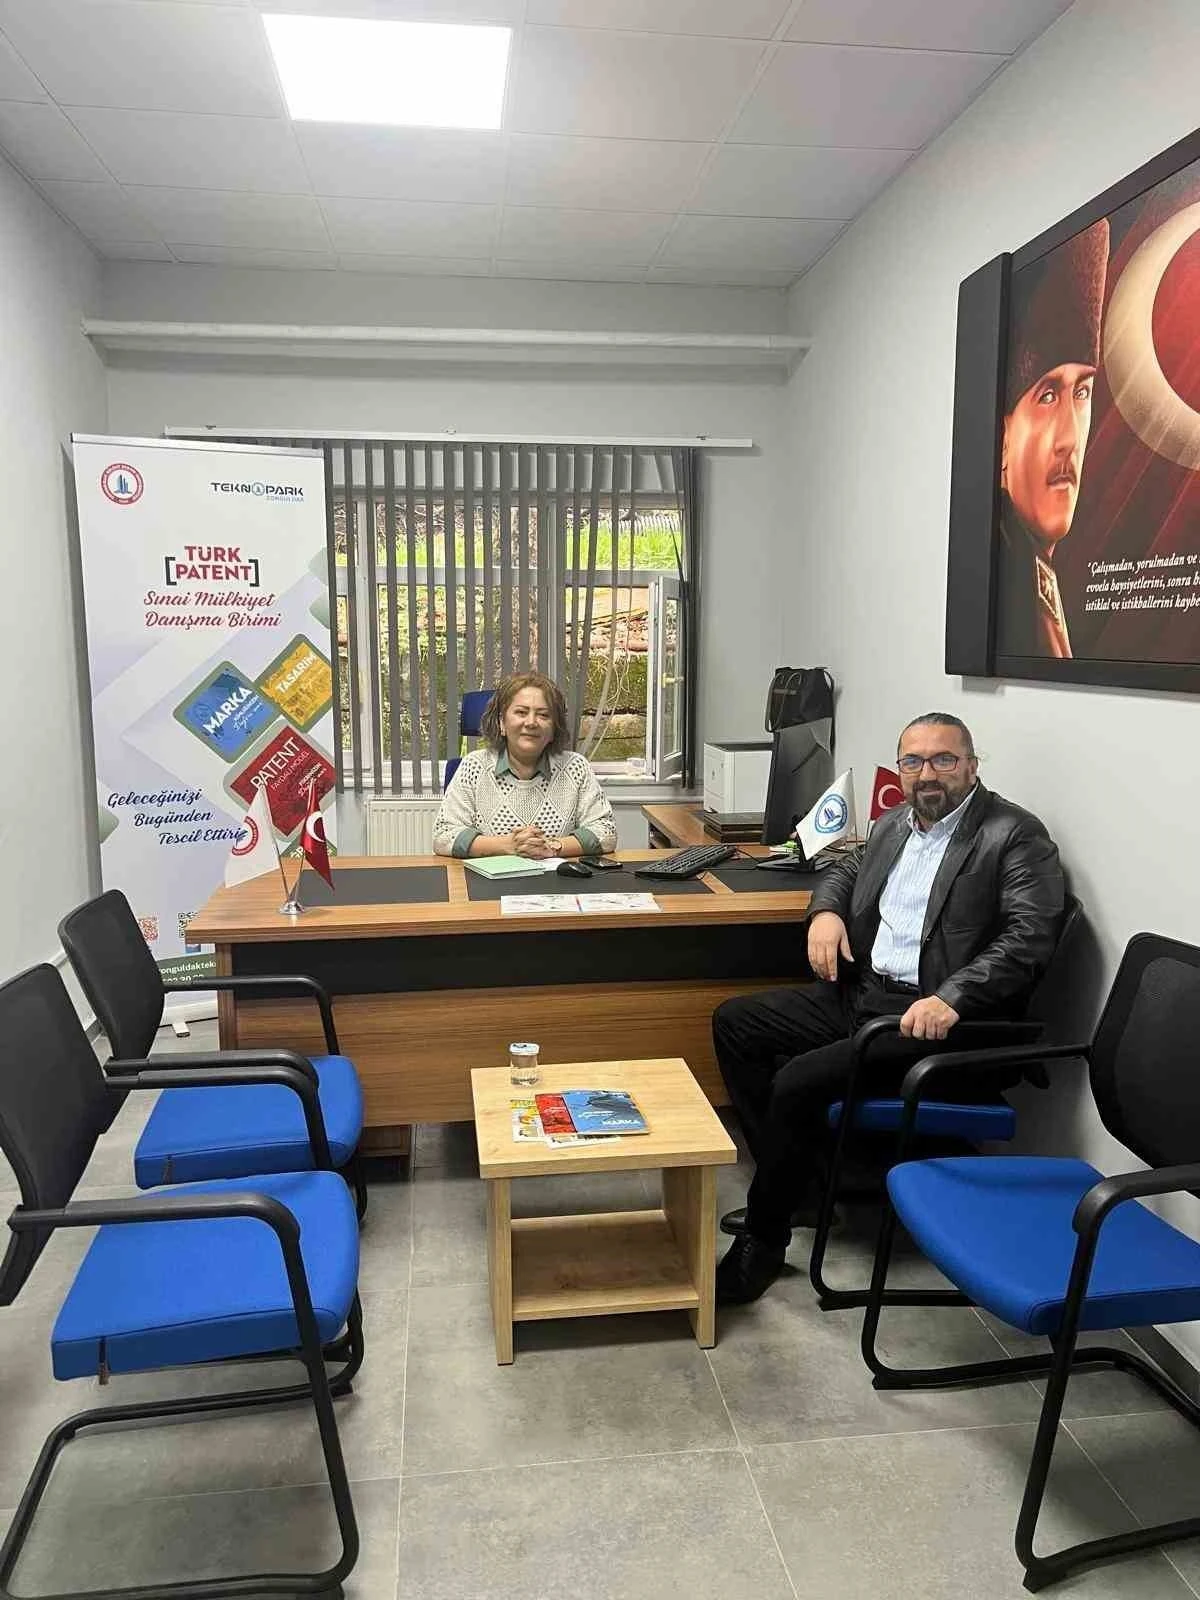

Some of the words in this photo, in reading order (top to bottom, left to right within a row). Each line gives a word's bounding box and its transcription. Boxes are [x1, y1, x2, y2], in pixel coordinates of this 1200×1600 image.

[184, 545, 242, 562] TÜRK
[1135, 553, 1184, 574] yorulmadan
[175, 563, 252, 581] PATENT
[1166, 576, 1192, 588] sonra
[144, 590, 191, 606] Sınai
[194, 591, 275, 611] Mülkiyet
[1085, 597, 1111, 611] istiklal
[1111, 601, 1120, 610] ve
[1121, 594, 1174, 610] istikballerini
[145, 610, 222, 630] Danışma
[227, 612, 281, 628] Birimi
[275, 652, 317, 694] TASARIM
[202, 686, 252, 734] MARKA
[250, 736, 300, 790] PATENT
[107, 788, 202, 809] Geleceğinizi
[134, 809, 213, 829] Bugünden
[159, 828, 201, 845] Tescil
